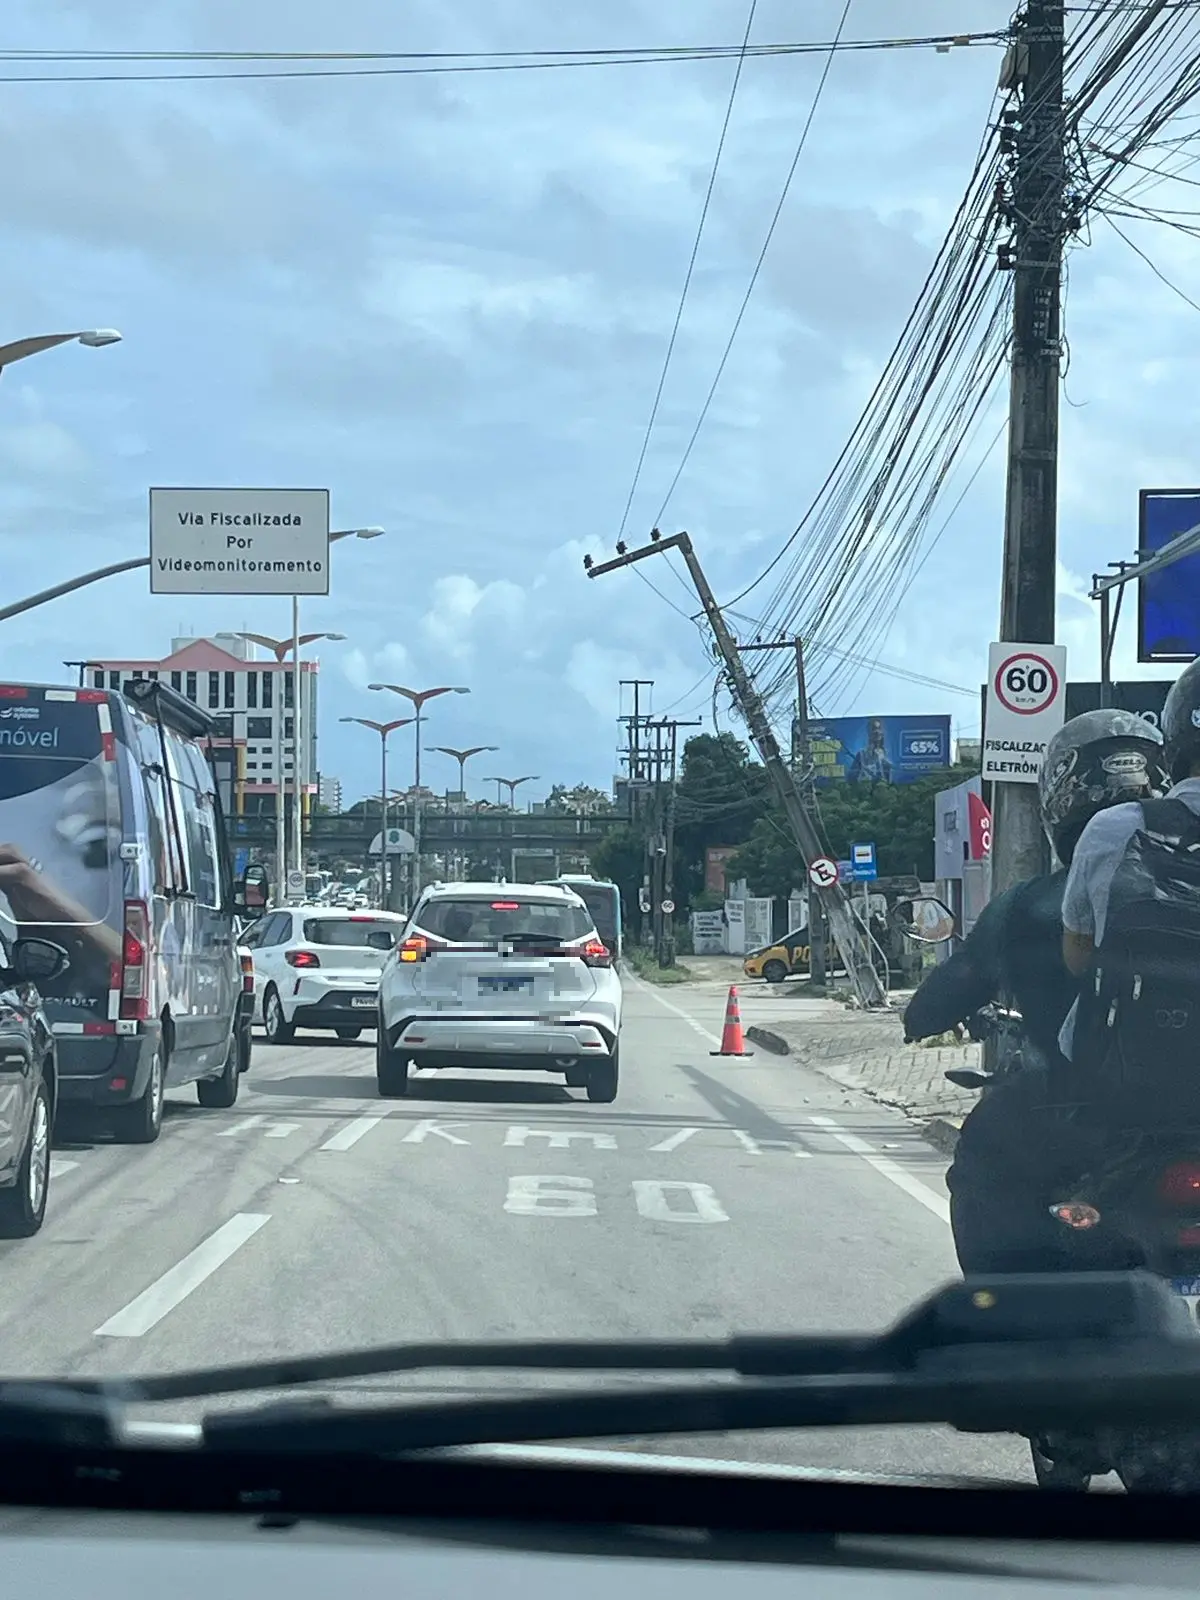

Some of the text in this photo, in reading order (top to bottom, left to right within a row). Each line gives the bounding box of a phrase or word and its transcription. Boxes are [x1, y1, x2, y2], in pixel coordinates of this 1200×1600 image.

[178, 512, 302, 527] Via Fiscalizada
[226, 535, 254, 549] Por
[157, 558, 323, 573] Videomonitoramento
[1006, 667, 1048, 693] 60
[910, 740, 940, 754] 65%
[40, 996, 98, 1007] ENAULT
[503, 1174, 731, 1224] 60
